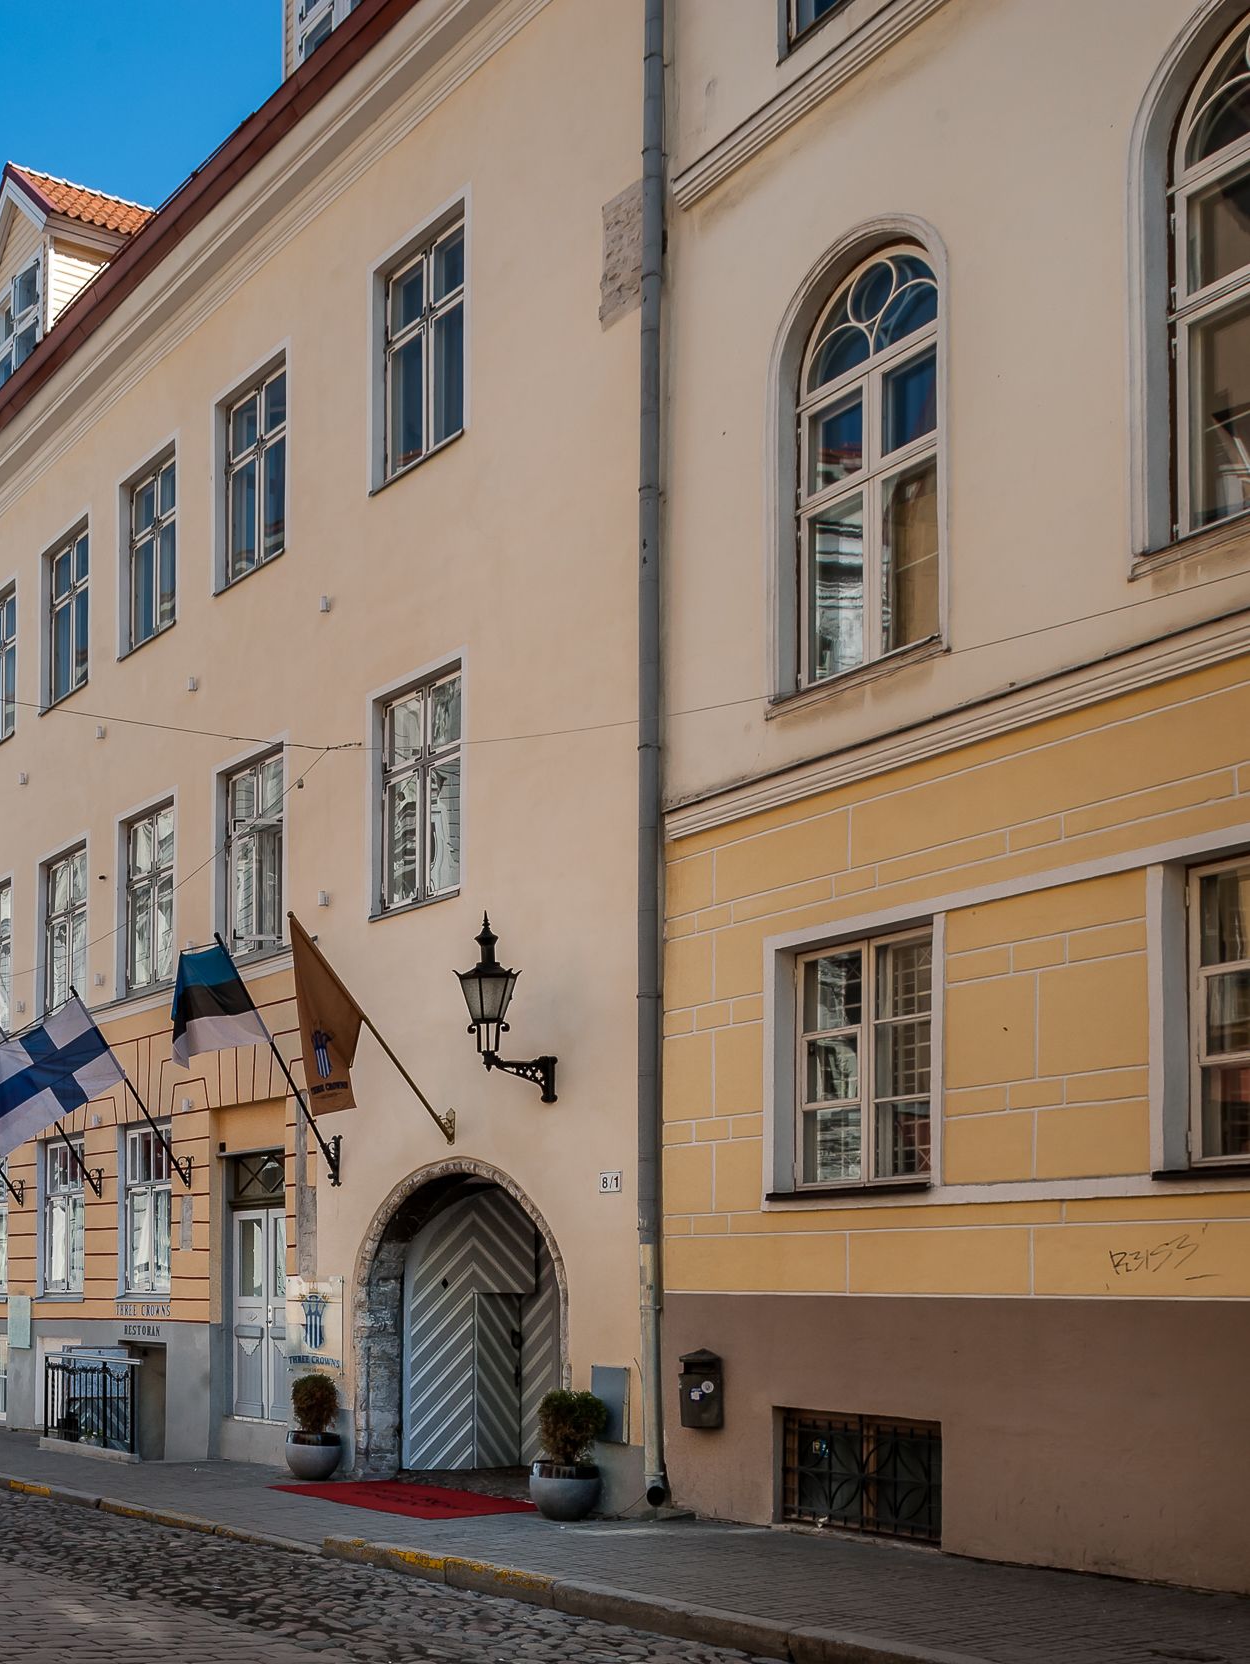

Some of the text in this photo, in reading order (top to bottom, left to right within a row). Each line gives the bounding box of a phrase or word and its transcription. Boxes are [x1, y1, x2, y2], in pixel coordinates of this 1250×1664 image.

[602, 1175, 619, 1189] 8/1
[116, 1304, 171, 1317] THREE CROWNS
[124, 1324, 161, 1336] RESTORAN
[288, 1355, 341, 1369] THREE CROWNS
